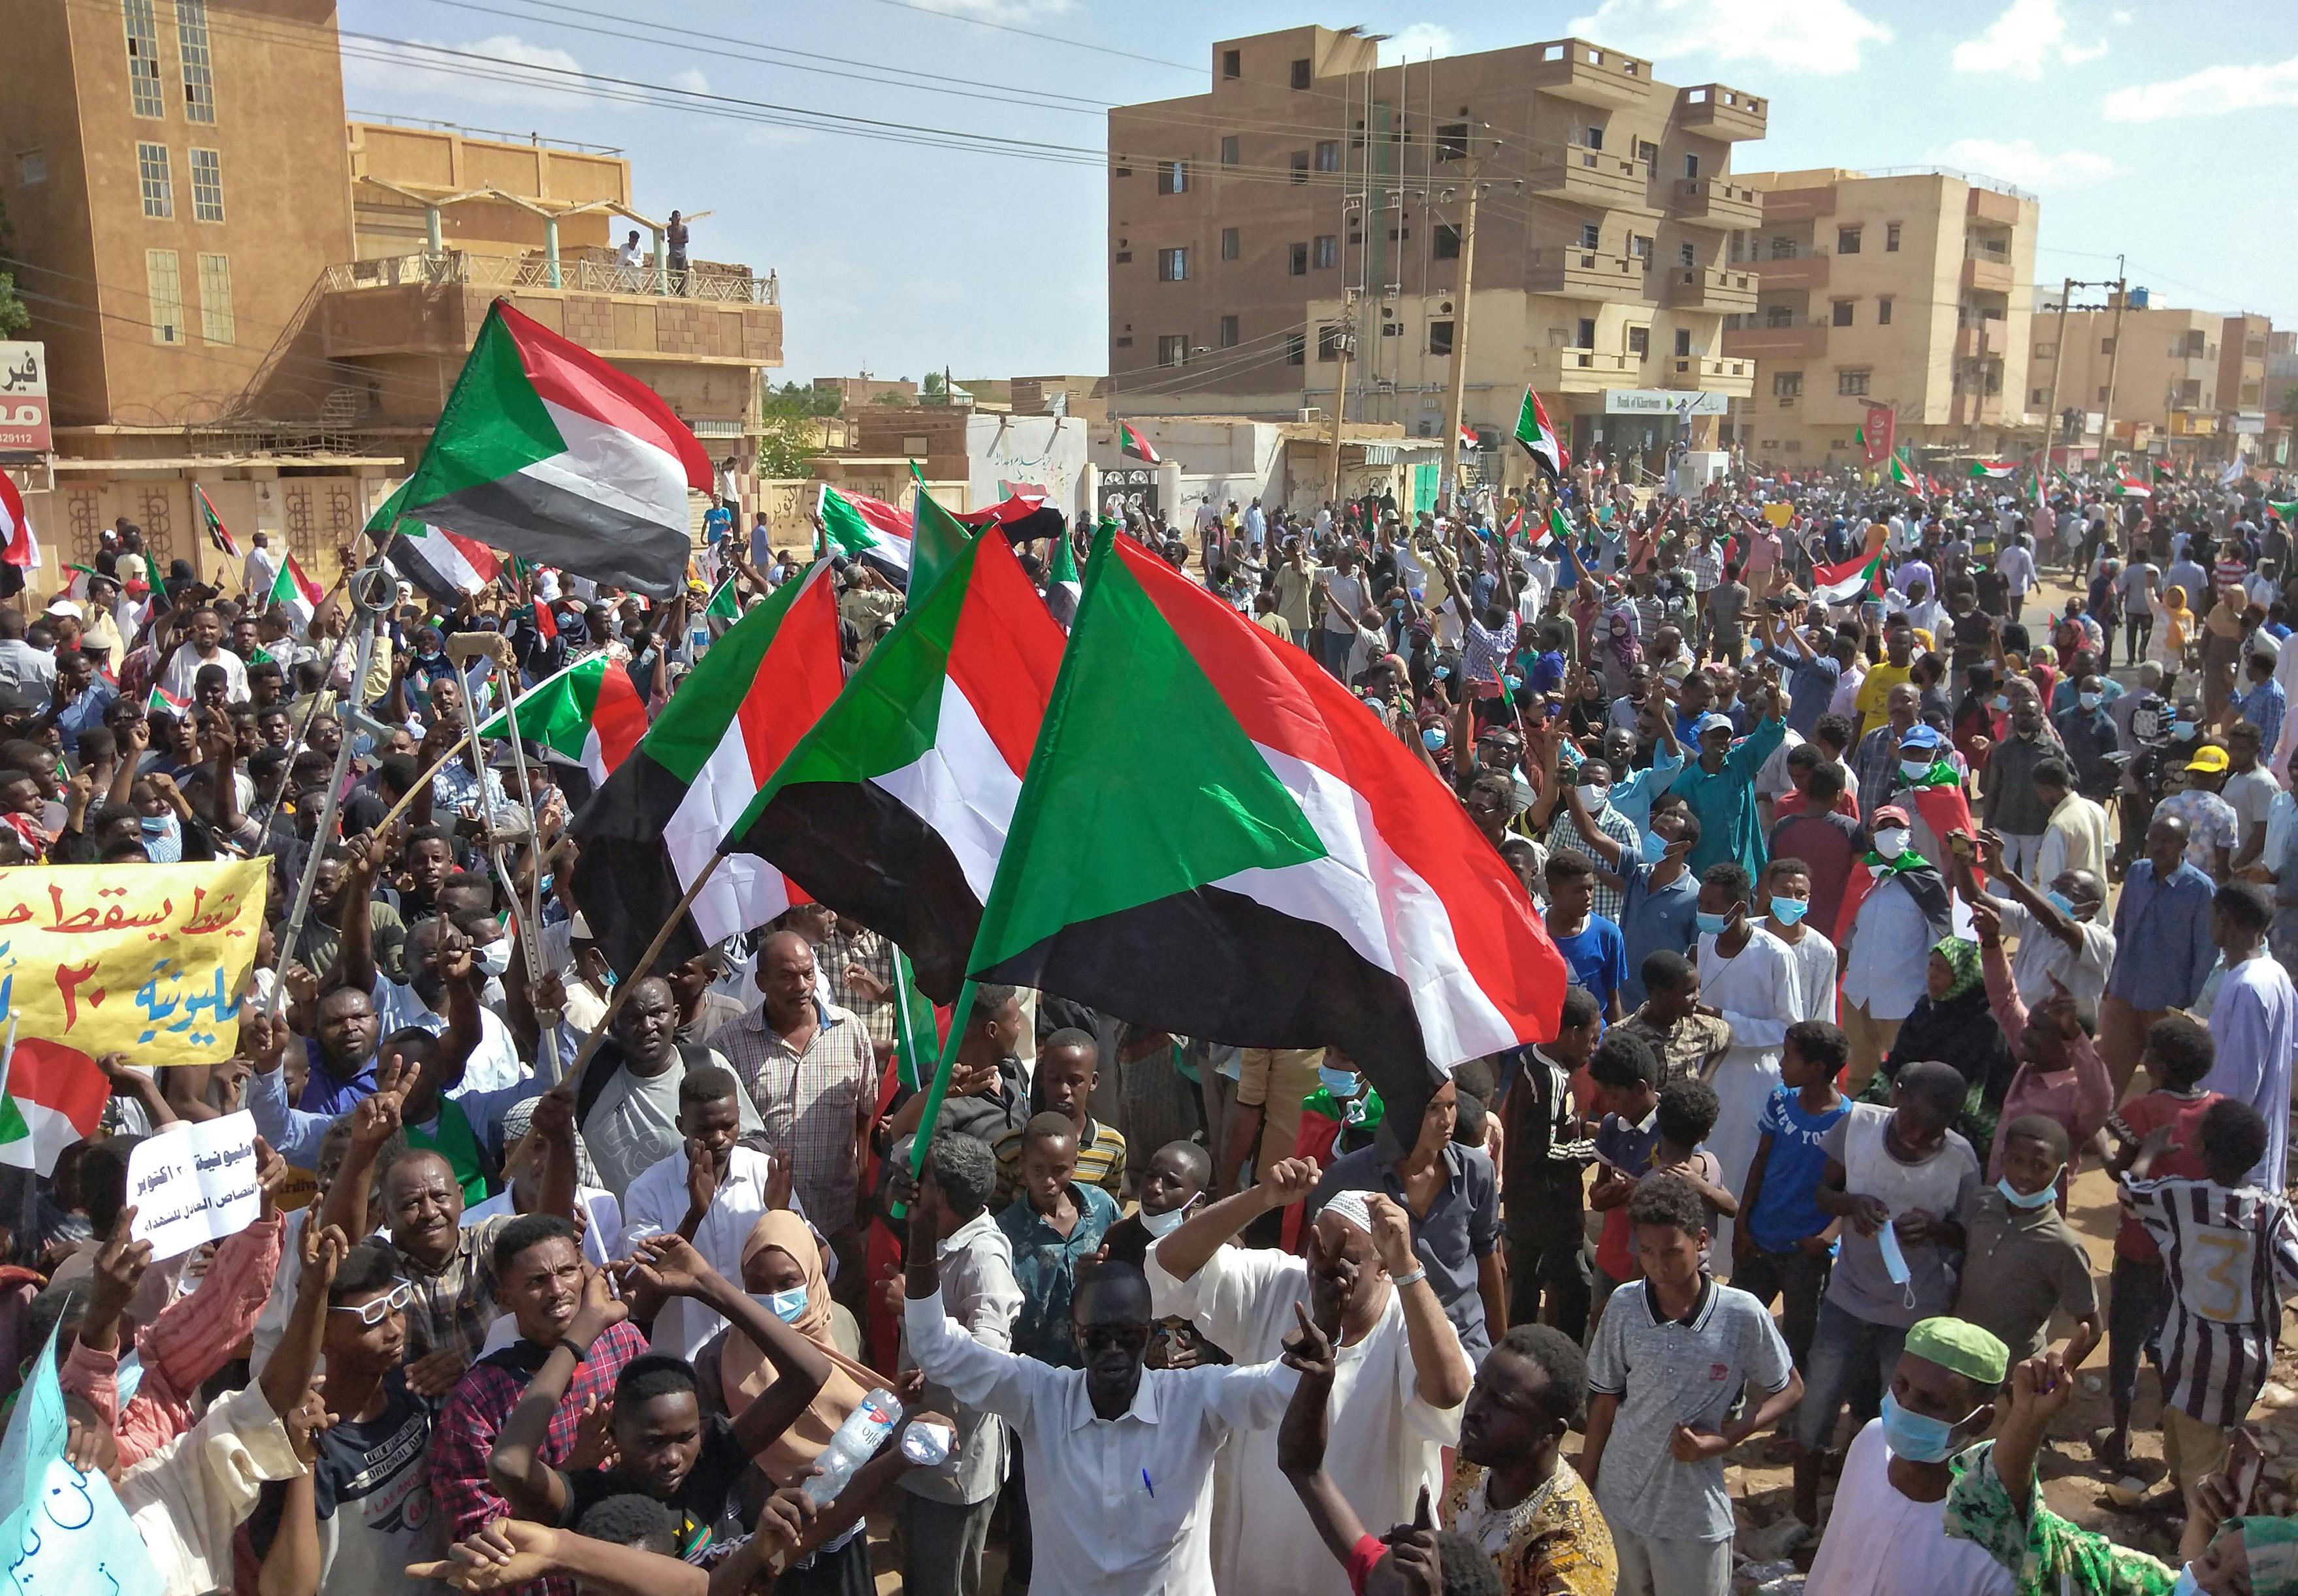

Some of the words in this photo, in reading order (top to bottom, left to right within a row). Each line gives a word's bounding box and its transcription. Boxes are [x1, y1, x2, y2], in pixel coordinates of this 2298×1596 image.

[1617, 396, 1630, 407] Bank
[40, 882, 174, 941] يسقط
[135, 958, 243, 1046] مليونية
[1775, 1103, 1798, 1136] NEW
[194, 1142, 252, 1172] مليونية
[184, 1196, 213, 1219] العادل
[216, 1182, 257, 1209] القصاص
[144, 1209, 181, 1232] للشهداء
[2197, 1234, 2248, 1322] 3
[368, 1448, 410, 1480] ORIGINAL
